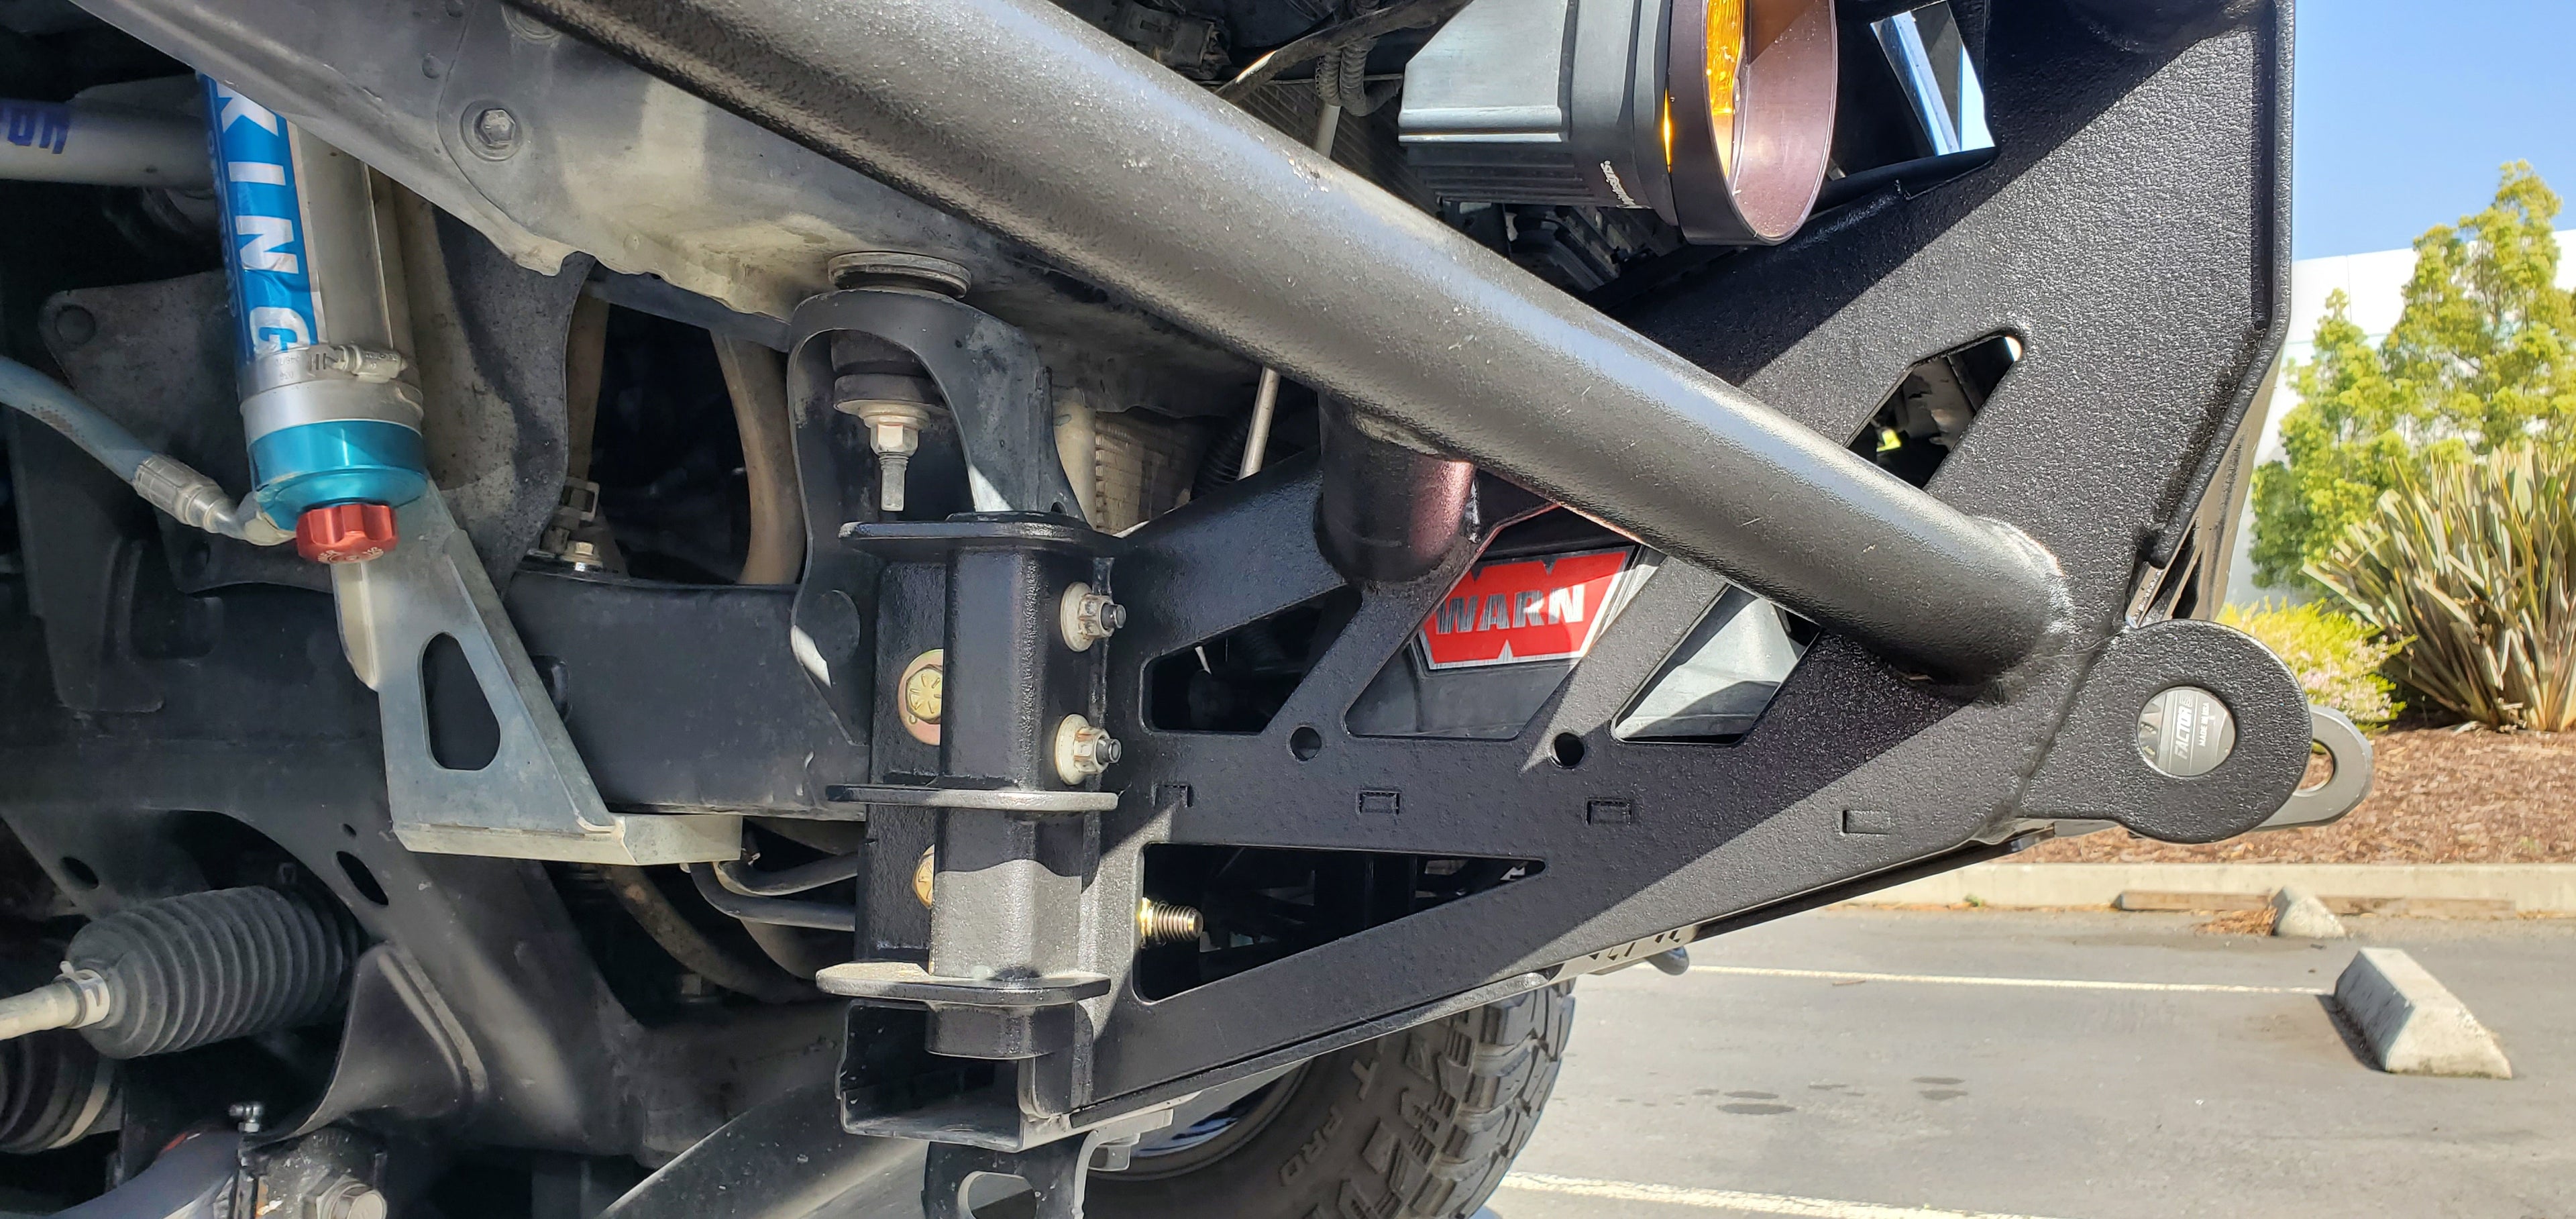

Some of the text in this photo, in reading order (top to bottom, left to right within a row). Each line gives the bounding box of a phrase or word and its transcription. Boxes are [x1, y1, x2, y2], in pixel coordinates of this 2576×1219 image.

[1434, 584, 1585, 635] WARN
[2174, 705, 2192, 759] FACTOR
[2198, 725, 2208, 747] MADE
[1279, 1107, 1342, 1186] PRO
